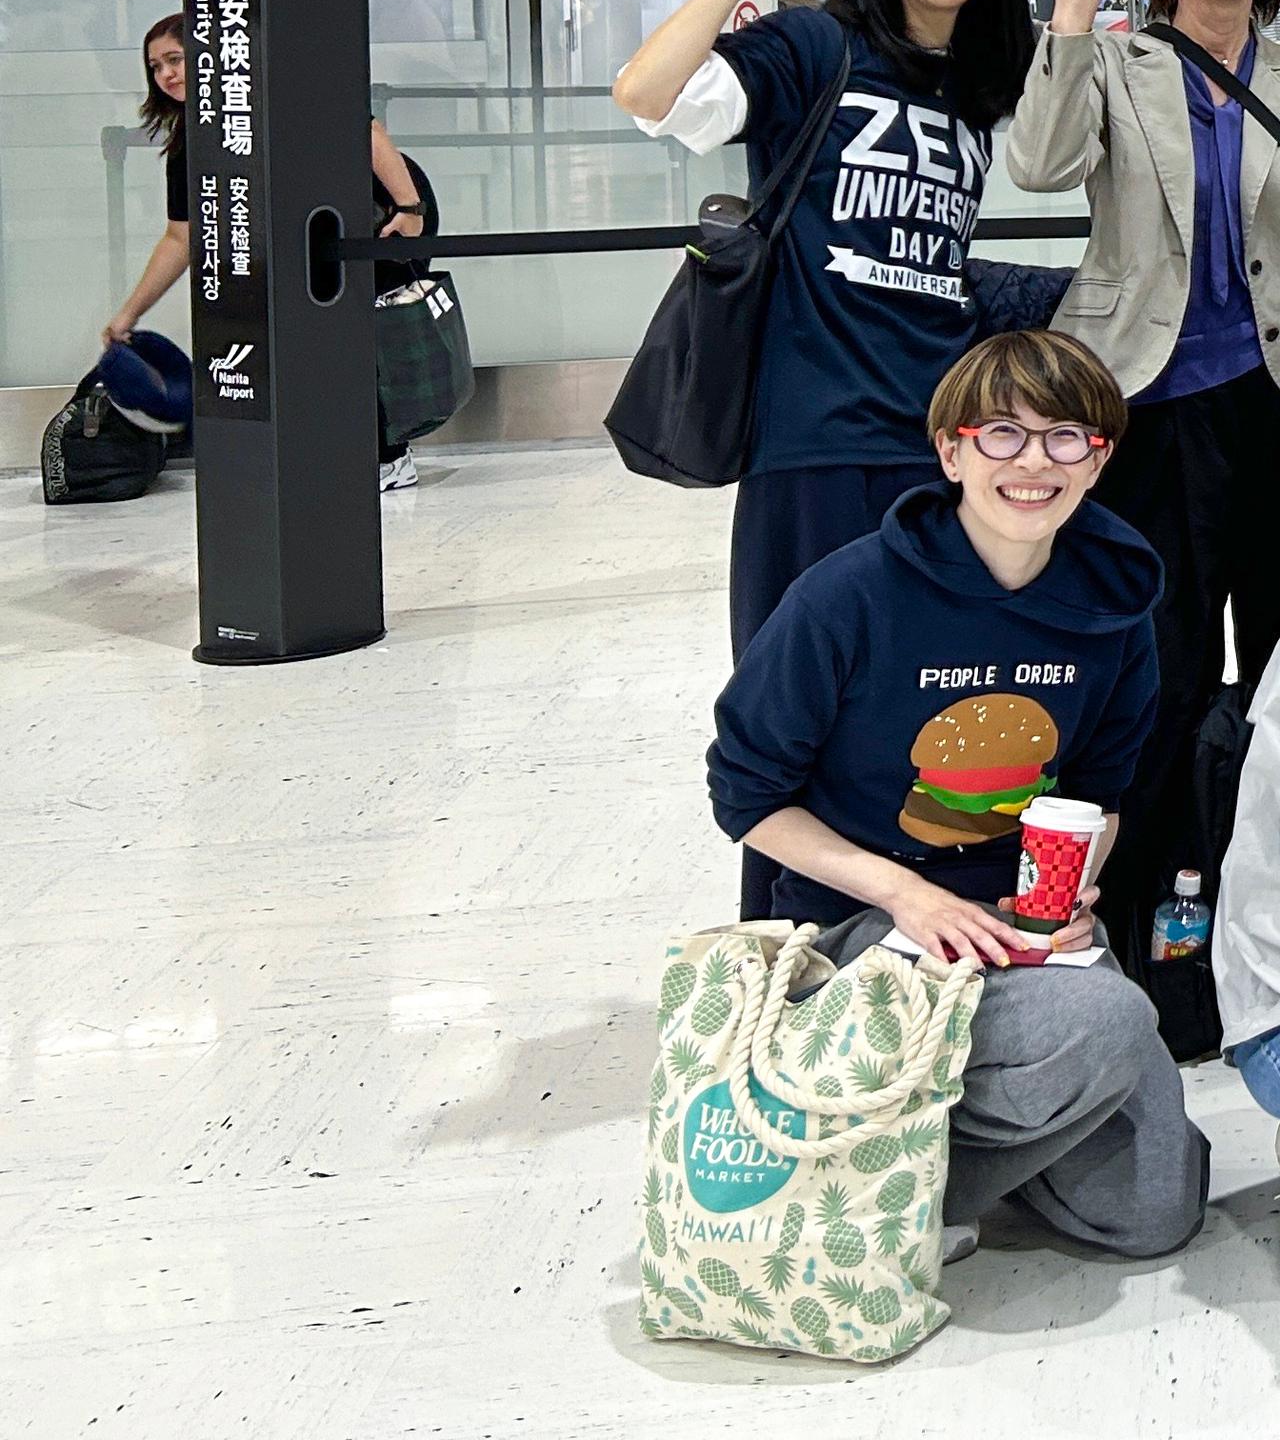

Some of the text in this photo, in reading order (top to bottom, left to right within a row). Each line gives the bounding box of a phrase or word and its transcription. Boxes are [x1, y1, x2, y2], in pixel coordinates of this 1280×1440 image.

[197, 52, 216, 125] Check
[839, 92, 993, 191] ZEN
[201, 175, 221, 301] 보안검사장
[229, 176, 250, 276] 安全检查
[890, 227, 944, 265] DAY
[218, 372, 249, 385] Narita
[219, 386, 254, 400] Airport
[920, 663, 1076, 688] PEOPLE ORDER
[695, 1168, 766, 1183] MARKET
